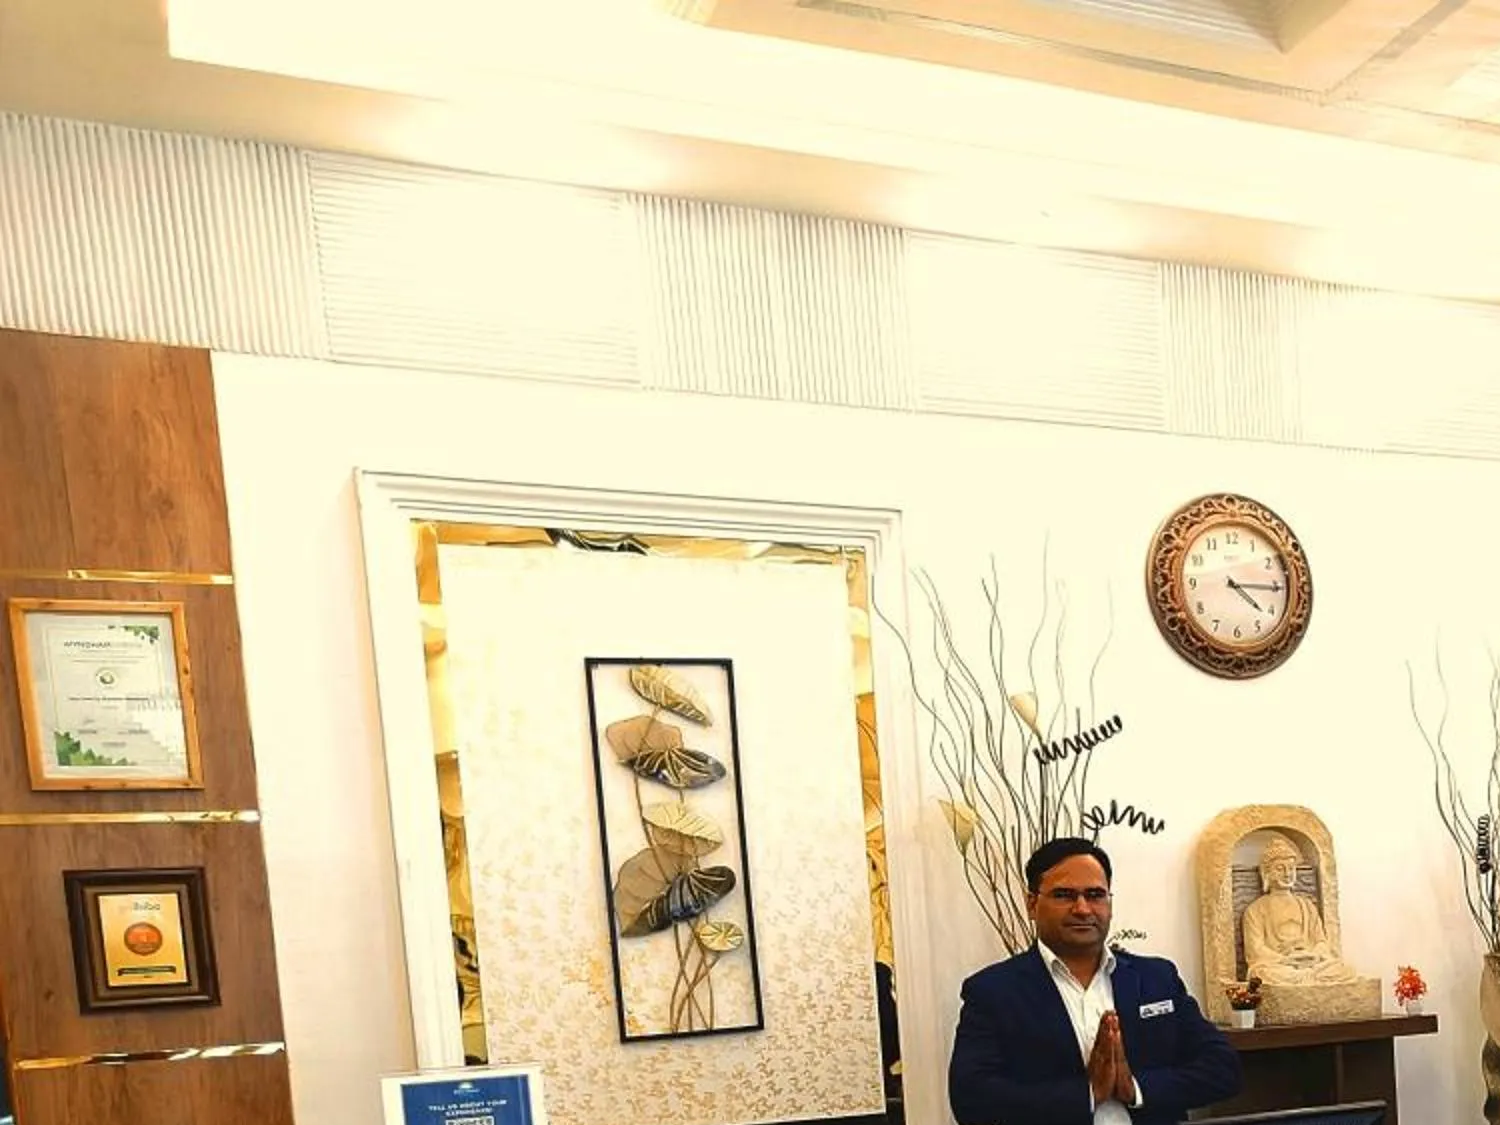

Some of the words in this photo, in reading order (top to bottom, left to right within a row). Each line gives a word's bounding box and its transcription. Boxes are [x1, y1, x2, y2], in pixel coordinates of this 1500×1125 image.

[1206, 537, 1217, 551] 11
[1225, 531, 1239, 545] 12
[1250, 538, 1255, 552] 1
[1264, 556, 1272, 570] 2
[1189, 577, 1197, 590] 9
[1197, 601, 1204, 614] 8
[1267, 604, 1275, 616] 4
[1212, 619, 1220, 632] 7
[1233, 625, 1242, 638] 6
[1254, 620, 1261, 633] 5
